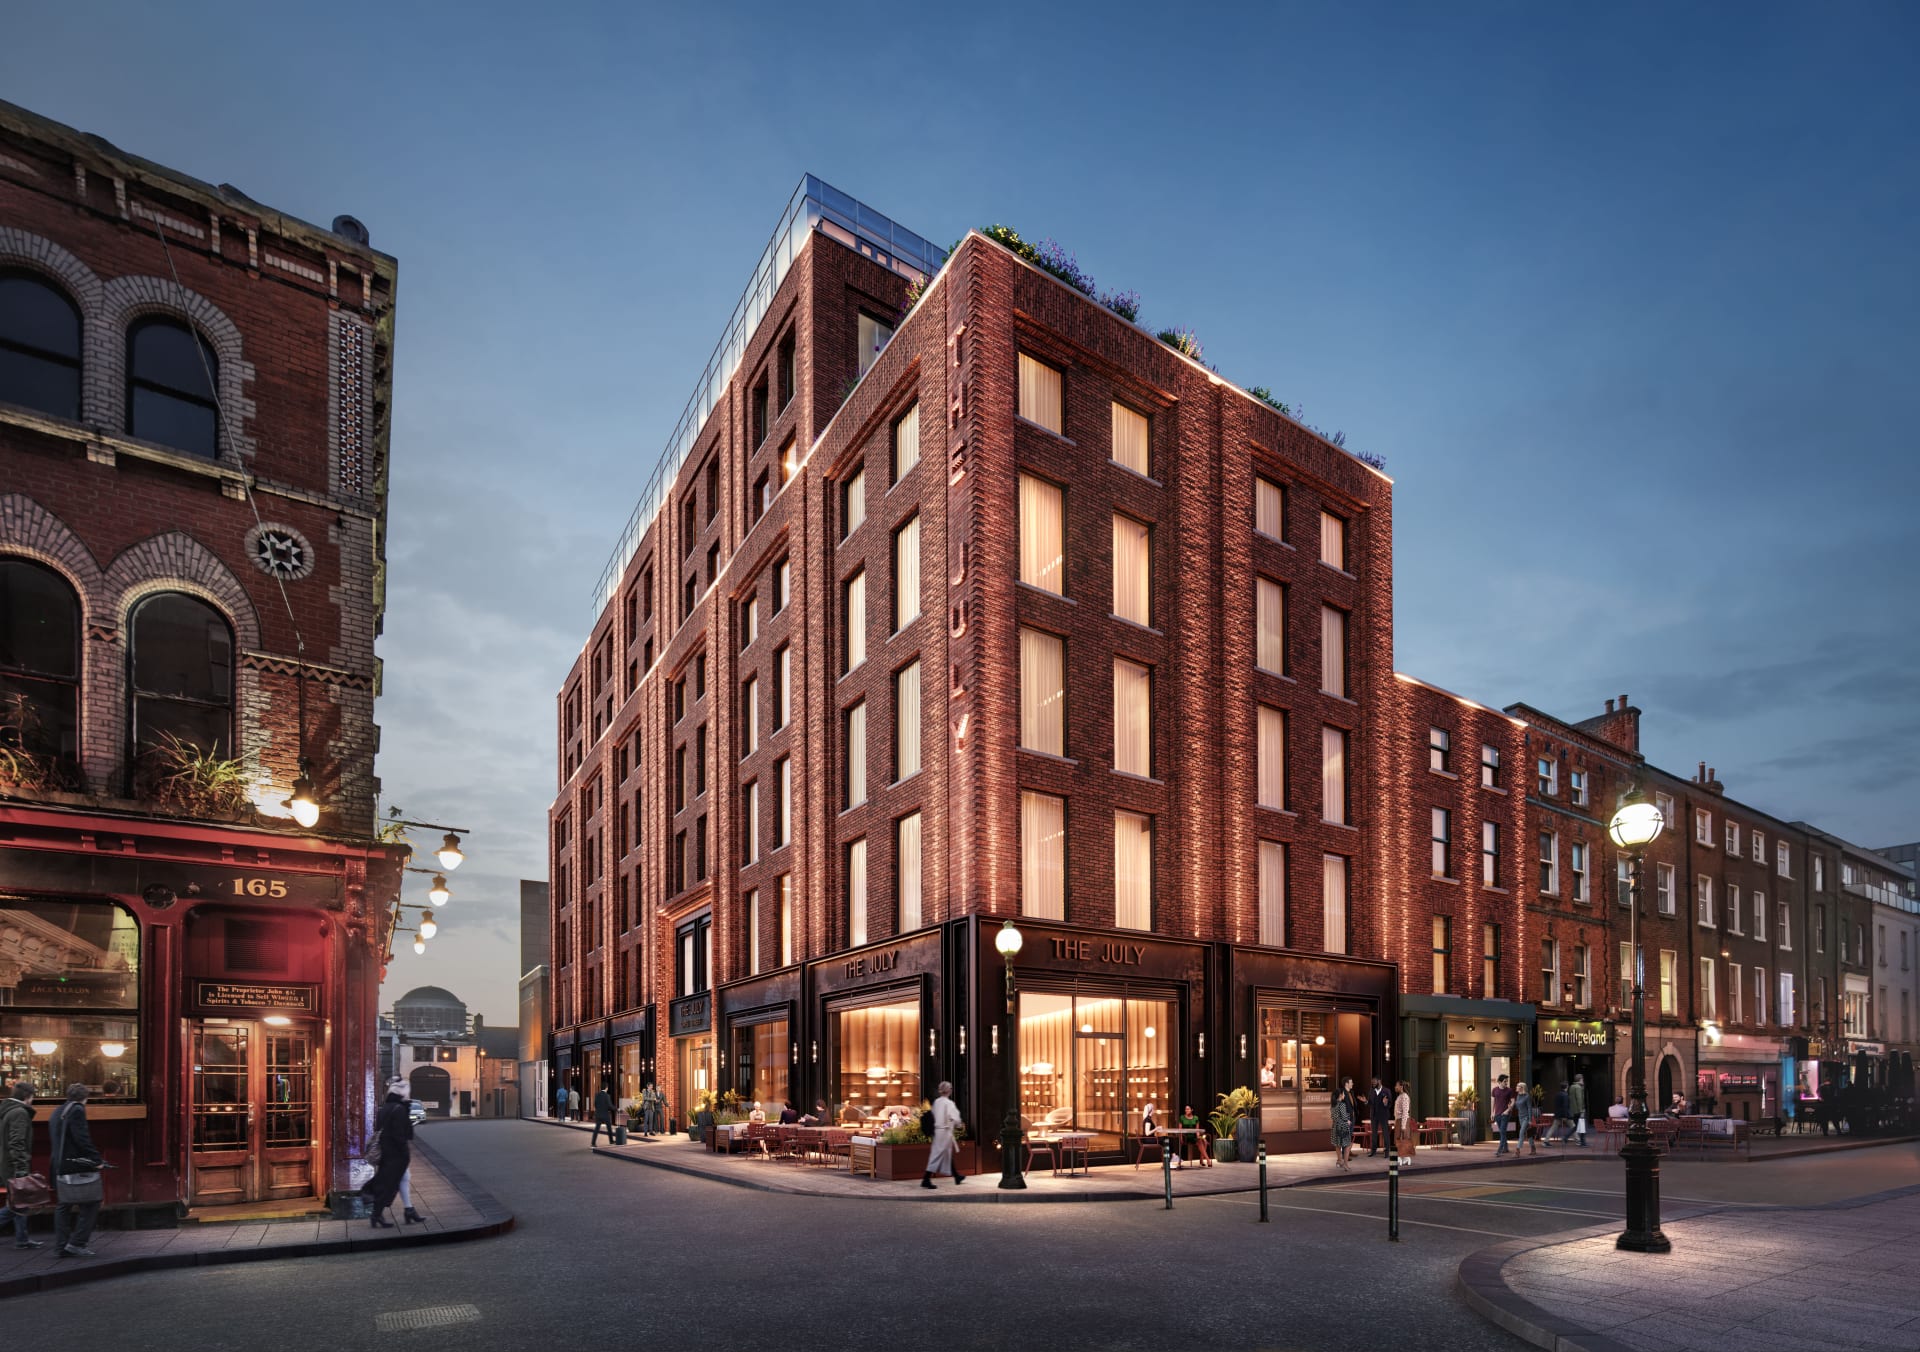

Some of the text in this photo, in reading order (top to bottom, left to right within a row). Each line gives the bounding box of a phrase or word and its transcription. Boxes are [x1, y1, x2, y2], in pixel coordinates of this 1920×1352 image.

[947, 320, 969, 753] THE JULY
[231, 877, 288, 898] 165
[1050, 937, 1146, 965] THE JULY
[842, 950, 897, 979] THE JULY
[206, 997, 230, 1005] Spirits
[256, 993, 269, 1001] Sell
